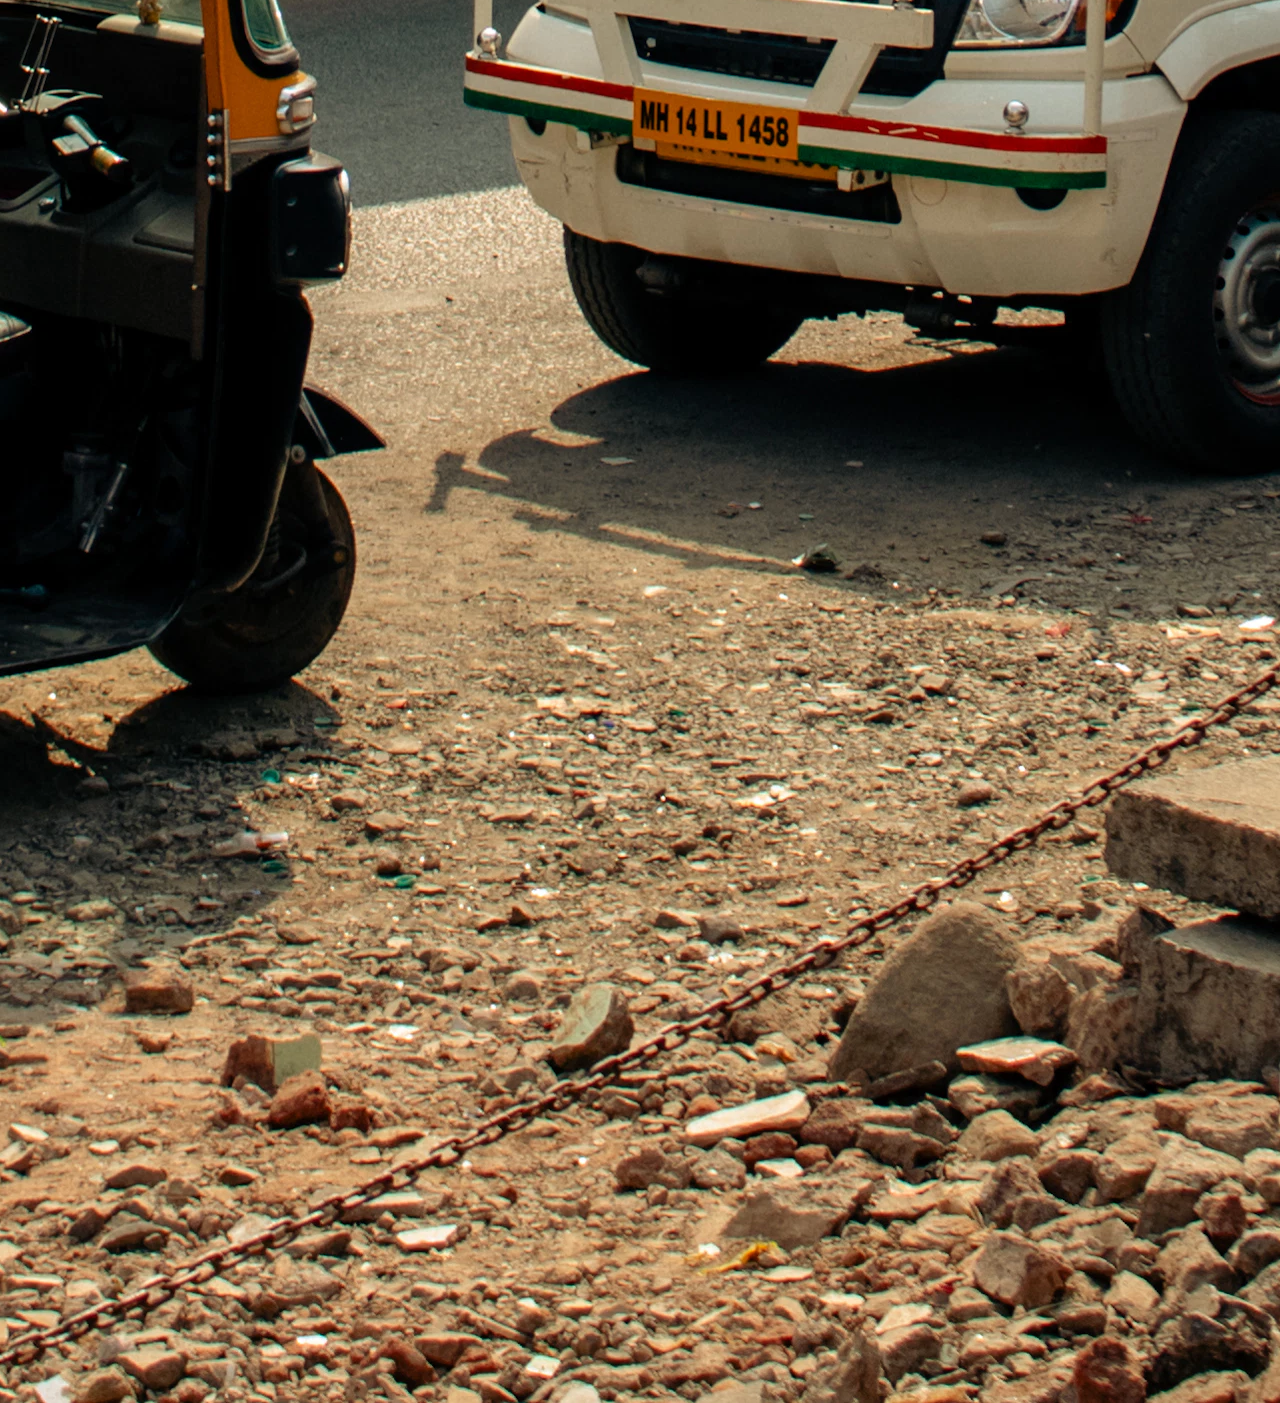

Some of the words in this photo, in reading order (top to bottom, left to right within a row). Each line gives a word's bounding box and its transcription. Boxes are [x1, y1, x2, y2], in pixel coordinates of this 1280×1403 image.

[640, 100, 669, 132] MH
[676, 106, 697, 137] 14
[703, 109, 728, 141] LL
[737, 114, 789, 147] 1458
